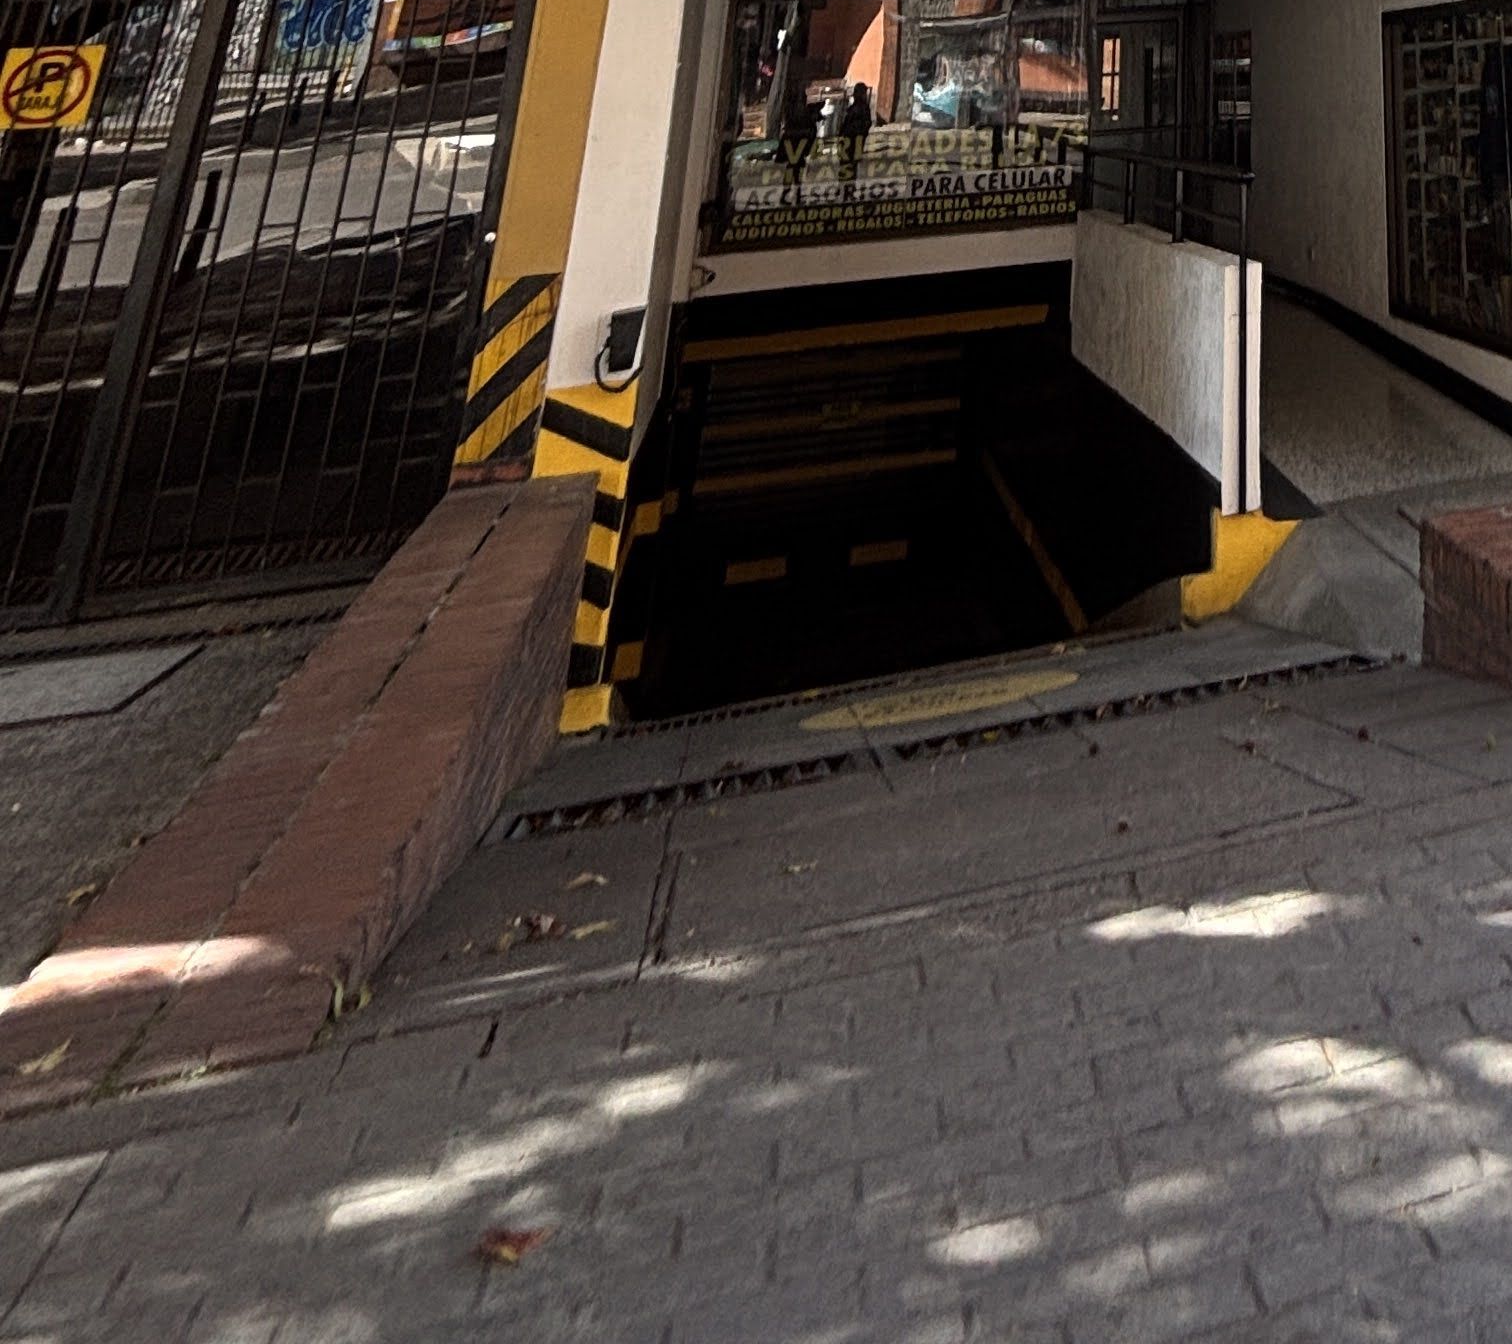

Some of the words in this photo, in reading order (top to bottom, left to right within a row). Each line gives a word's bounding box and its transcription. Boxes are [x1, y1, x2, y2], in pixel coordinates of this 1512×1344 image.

[732, 202, 865, 226] CALCULADORAS
[873, 195, 970, 216] JUGUETERIA
[982, 188, 1068, 207] PARAGUAS
[744, 180, 899, 210] ACCESORIOS
[911, 175, 966, 197] PARA
[974, 167, 1066, 192] CELULAR
[722, 221, 825, 242] AUDIFONOS
[837, 214, 904, 233] REGALOS
[918, 206, 1008, 225] TELEFONOS
[1017, 200, 1077, 217] RADIOS
